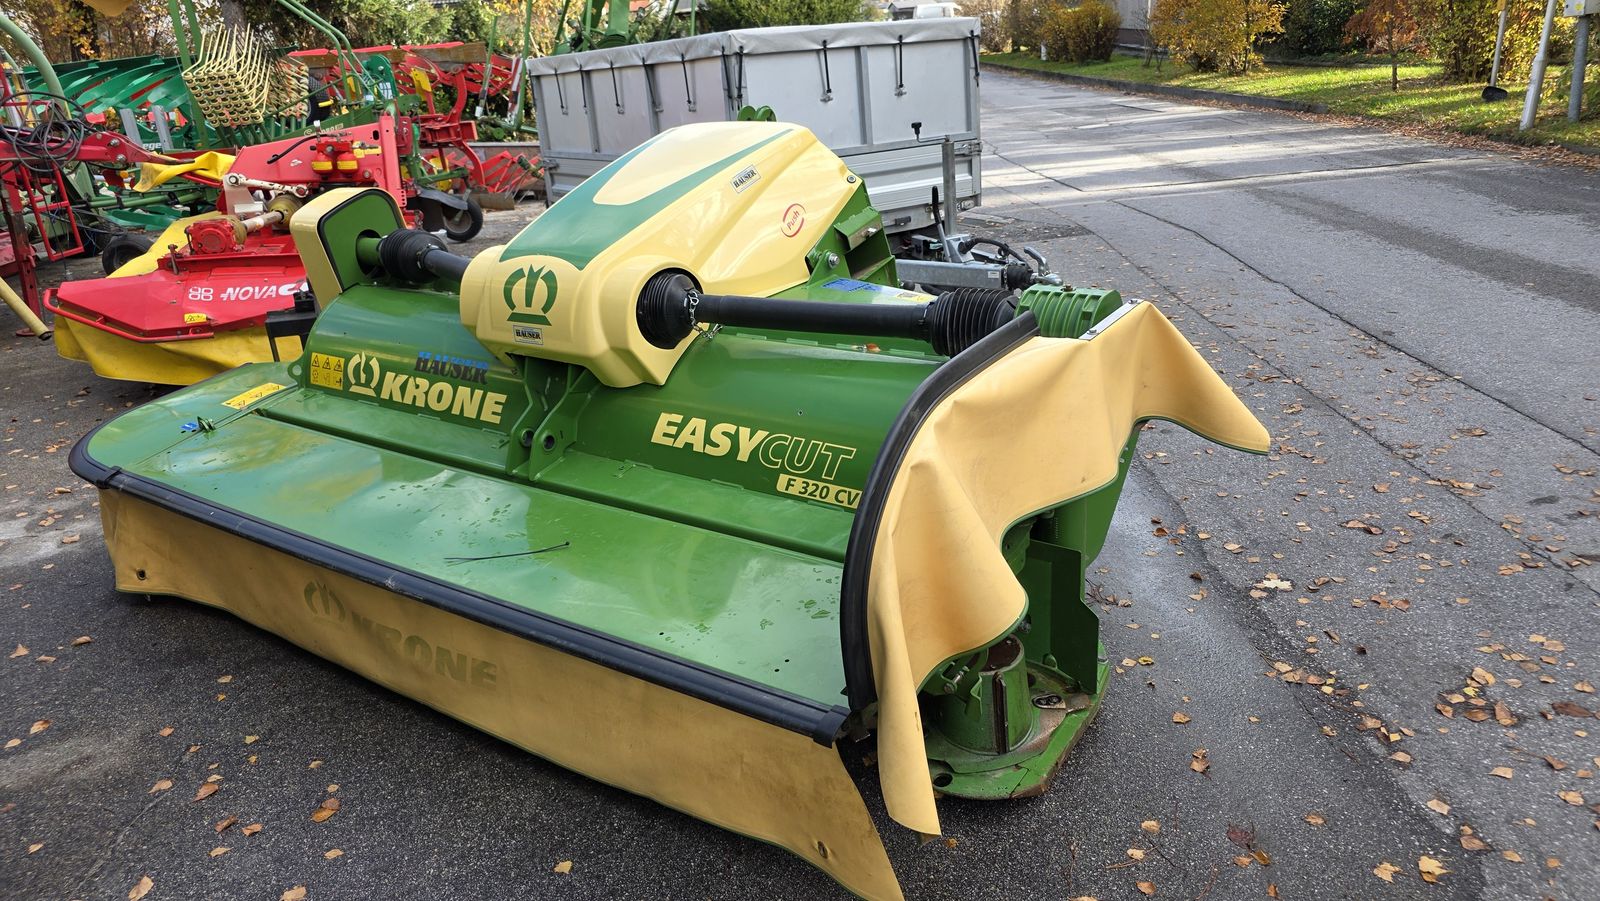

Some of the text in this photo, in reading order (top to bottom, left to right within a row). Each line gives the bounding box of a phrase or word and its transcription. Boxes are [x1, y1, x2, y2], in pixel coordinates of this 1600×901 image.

[142, 142, 162, 151] ege
[733, 169, 757, 188] HAUSER
[786, 210, 800, 231] Push
[515, 329, 541, 340] HAUSER
[414, 351, 490, 385] HAUSER
[380, 371, 507, 424] KRONE
[651, 412, 856, 480] EASYCUT
[785, 478, 795, 492] F
[798, 480, 830, 500] 320
[351, 611, 497, 690] KRONE
